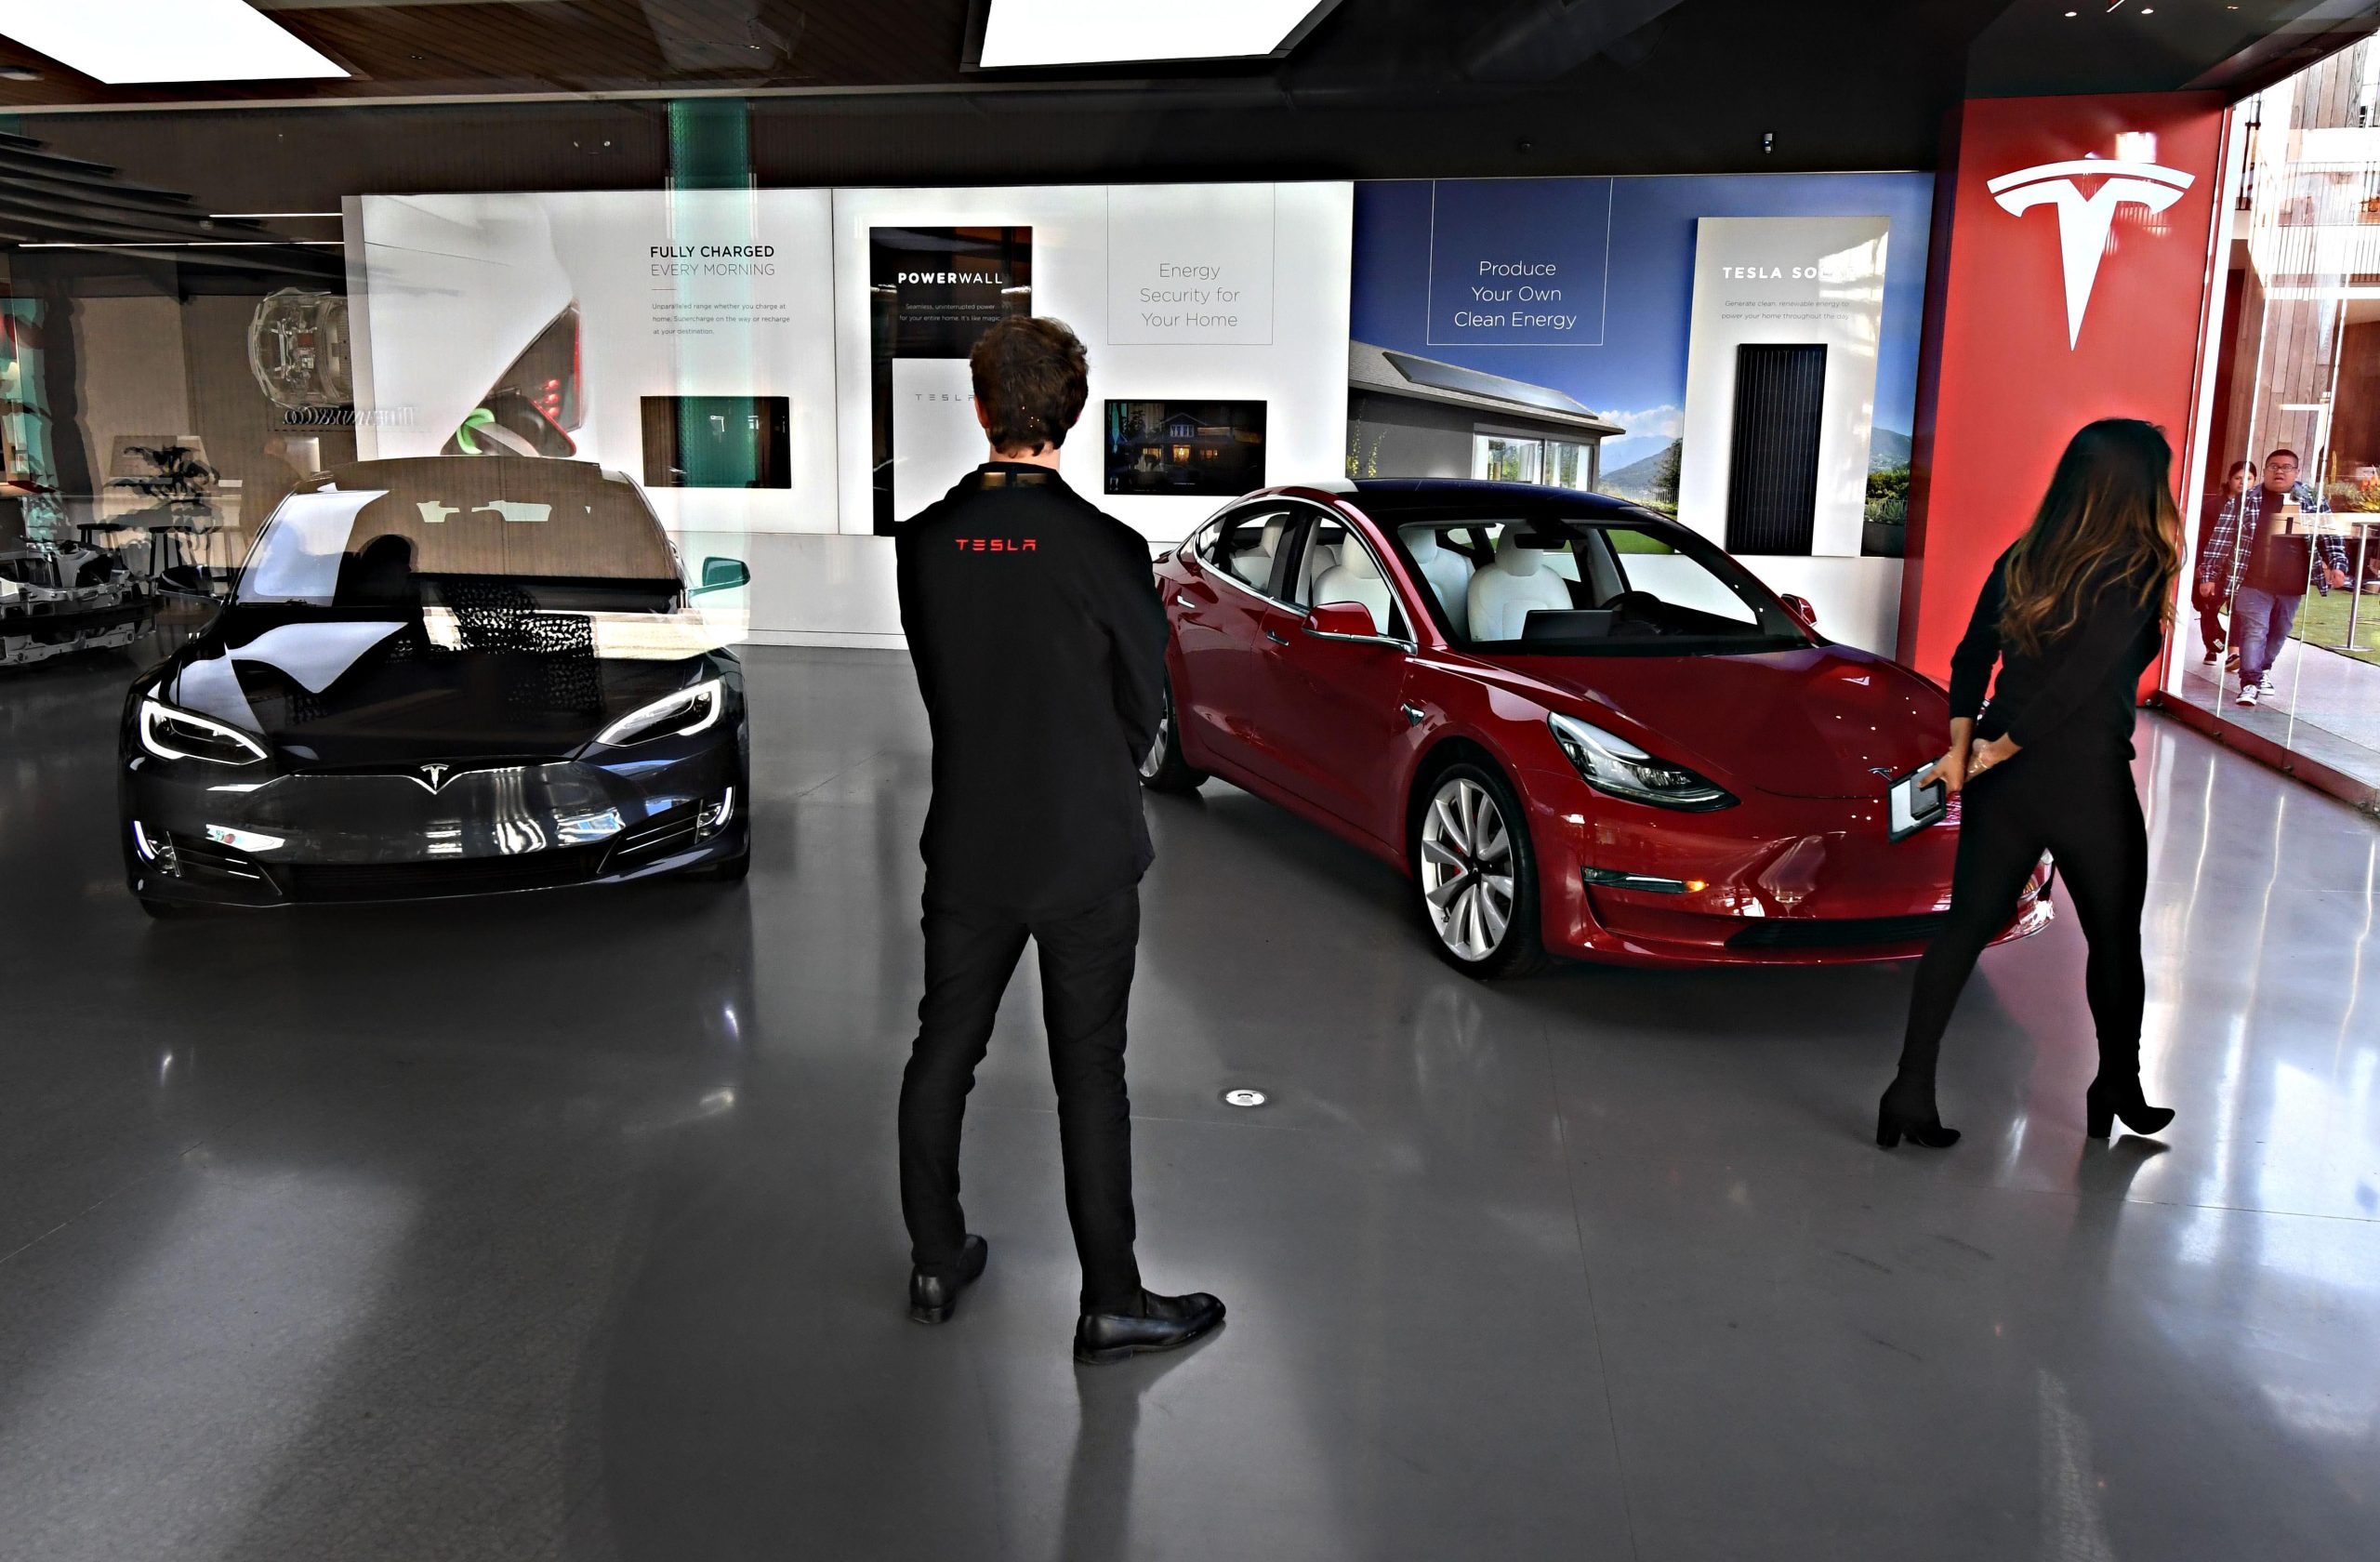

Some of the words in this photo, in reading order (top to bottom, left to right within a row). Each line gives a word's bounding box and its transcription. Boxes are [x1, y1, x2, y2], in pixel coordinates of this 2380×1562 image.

[651, 246, 695, 258] FULLY
[700, 245, 774, 258] CHARGED
[652, 264, 698, 276] EVERY
[704, 263, 775, 276] MORNING
[1159, 263, 1221, 280] Energy
[1479, 260, 1556, 276] Produce
[1723, 267, 1782, 279] TESLA
[898, 272, 1002, 284] POWERWALL
[1140, 287, 1210, 305] Security
[1217, 287, 1240, 302] for
[1472, 286, 1513, 301] Your
[1518, 286, 1561, 301] Own
[1141, 312, 1180, 327] Your
[1186, 312, 1237, 327] Home
[1454, 311, 1505, 327] Clean
[1512, 311, 1577, 329] Energy
[955, 539, 1037, 550] TESLA
